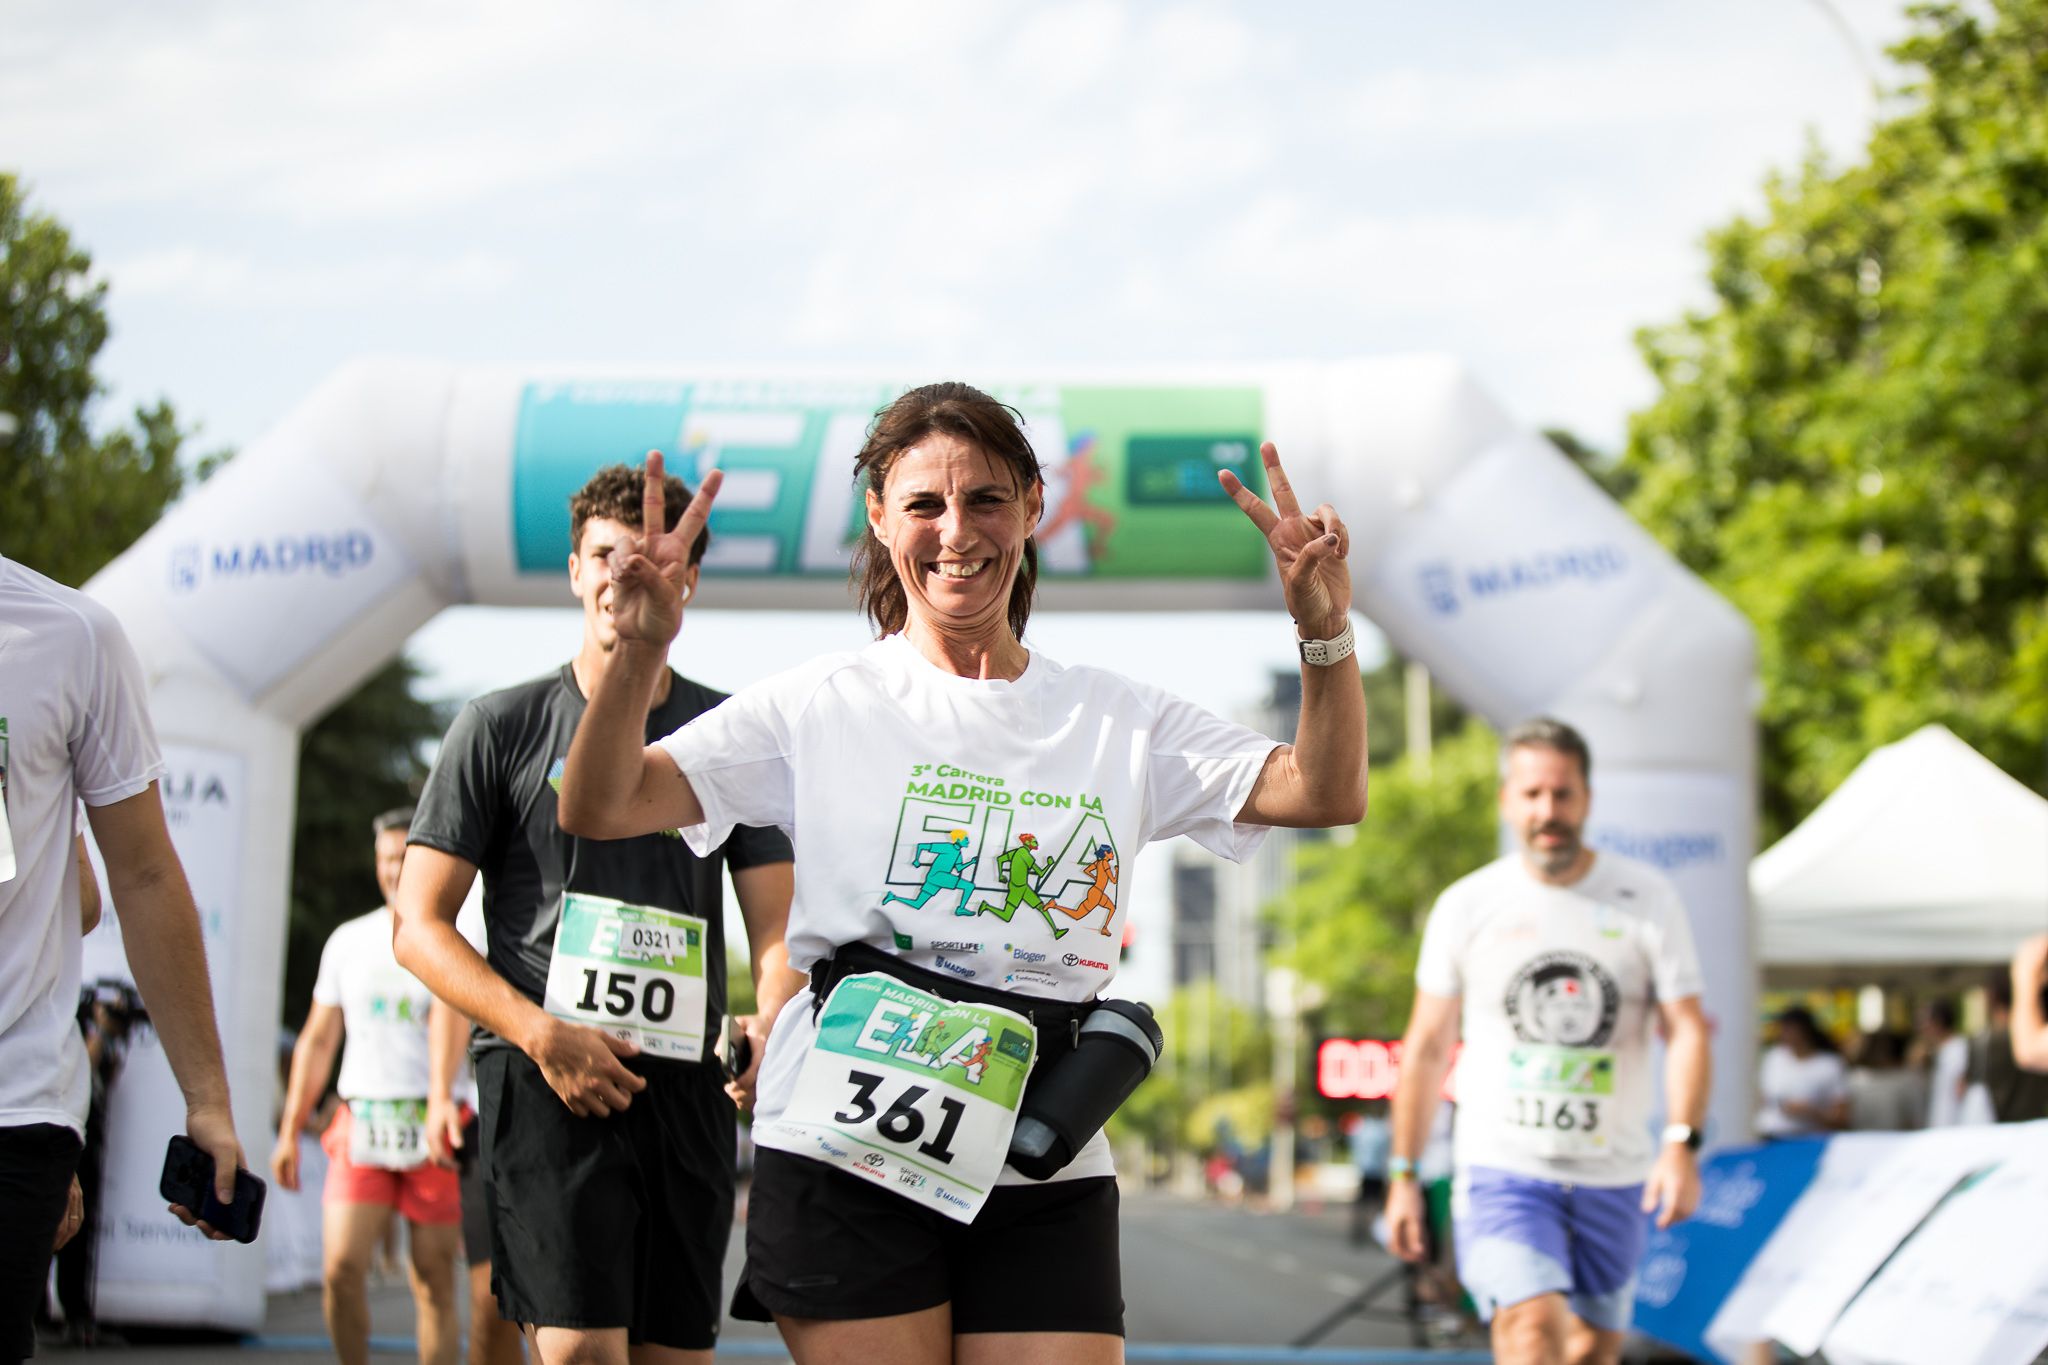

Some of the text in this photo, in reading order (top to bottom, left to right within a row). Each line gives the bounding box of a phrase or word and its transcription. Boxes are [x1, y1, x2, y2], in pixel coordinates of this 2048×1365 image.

[213, 530, 373, 577] MADRID
[936, 764, 1005, 787] Carrera
[906, 781, 1104, 814] MADRID CON LA
[885, 797, 1119, 909] ELA
[633, 928, 670, 949] 0321
[1013, 949, 1046, 964] Biogen
[944, 960, 976, 978] MADRID
[576, 968, 675, 1023] 150
[881, 987, 940, 1013] MADRID
[939, 1007, 992, 1027] CON LA
[854, 998, 990, 1085] ELA
[834, 1069, 967, 1165] 361
[1515, 1098, 1599, 1132] 1163
[899, 1174, 916, 1187] LIFE
[900, 1166, 922, 1180] SPORT
[943, 1191, 971, 1210] MADRID
